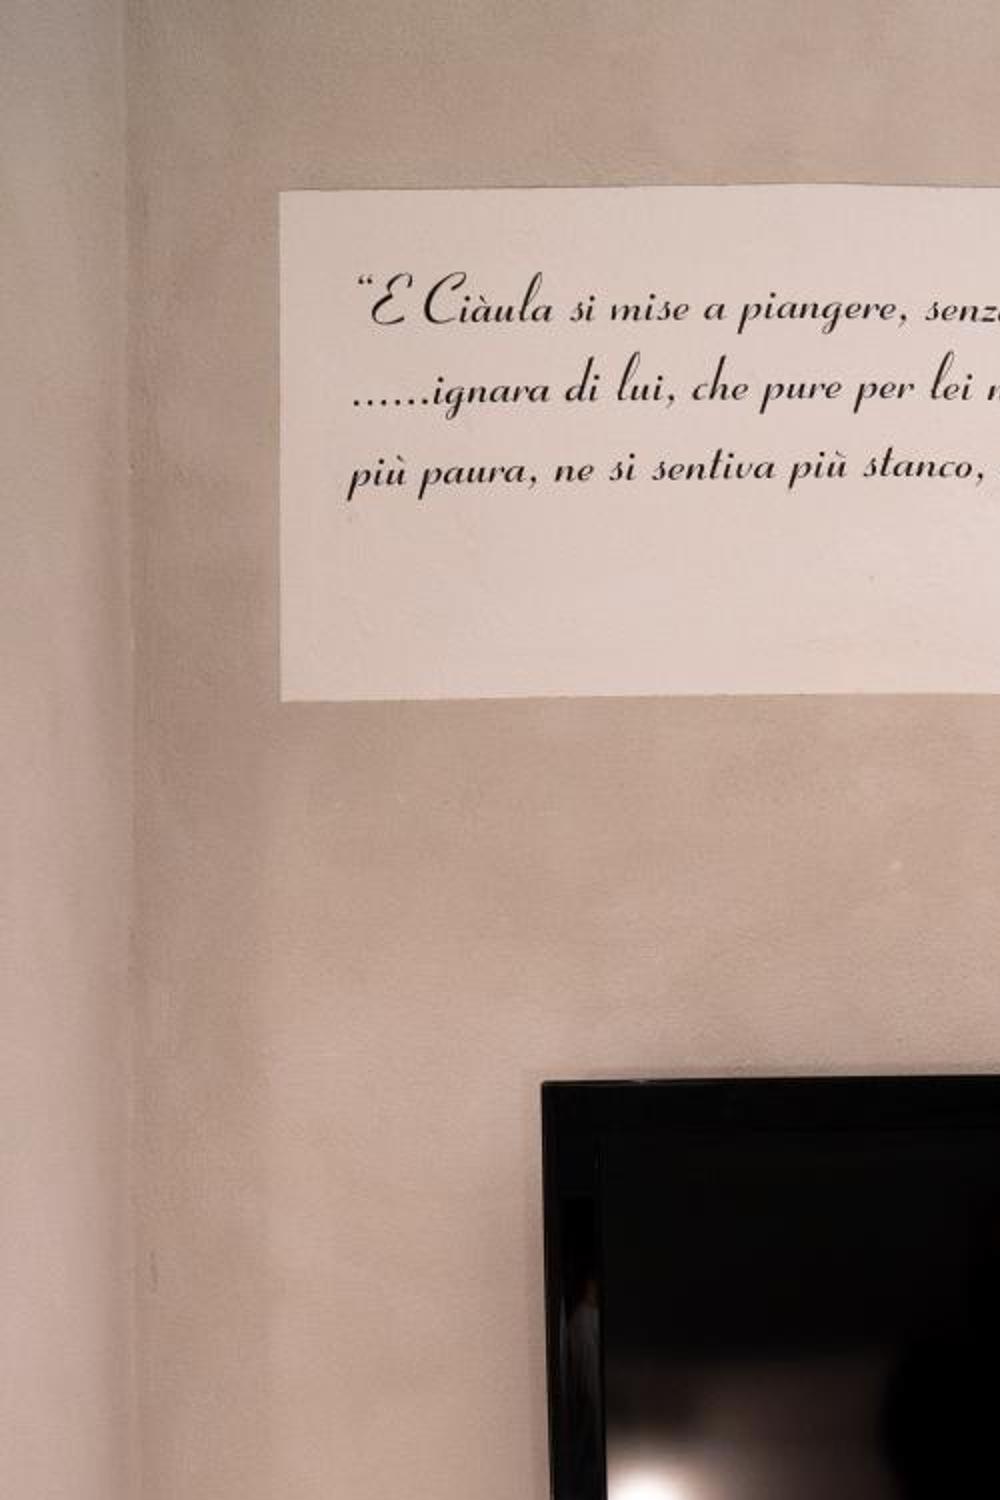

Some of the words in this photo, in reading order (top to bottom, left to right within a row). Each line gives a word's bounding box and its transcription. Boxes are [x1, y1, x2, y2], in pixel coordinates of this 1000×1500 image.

[423, 271, 553, 325] Ciàula
[569, 294, 596, 322] si
[610, 293, 690, 322] mise
[703, 303, 726, 321] a
[737, 291, 907, 335] piangere,
[564, 355, 601, 402] di
[617, 351, 675, 405] lui,
[691, 354, 749, 401] che
[759, 381, 843, 415] pure
[853, 382, 915, 415] per
[930, 350, 973, 401] lei
[346, 454, 405, 502] più
[417, 465, 537, 501] paura,
[554, 464, 595, 483] ne
[608, 452, 636, 482] si
[651, 448, 775, 481] sentiva
[787, 450, 847, 490] più
[863, 446, 984, 482] stanco,
